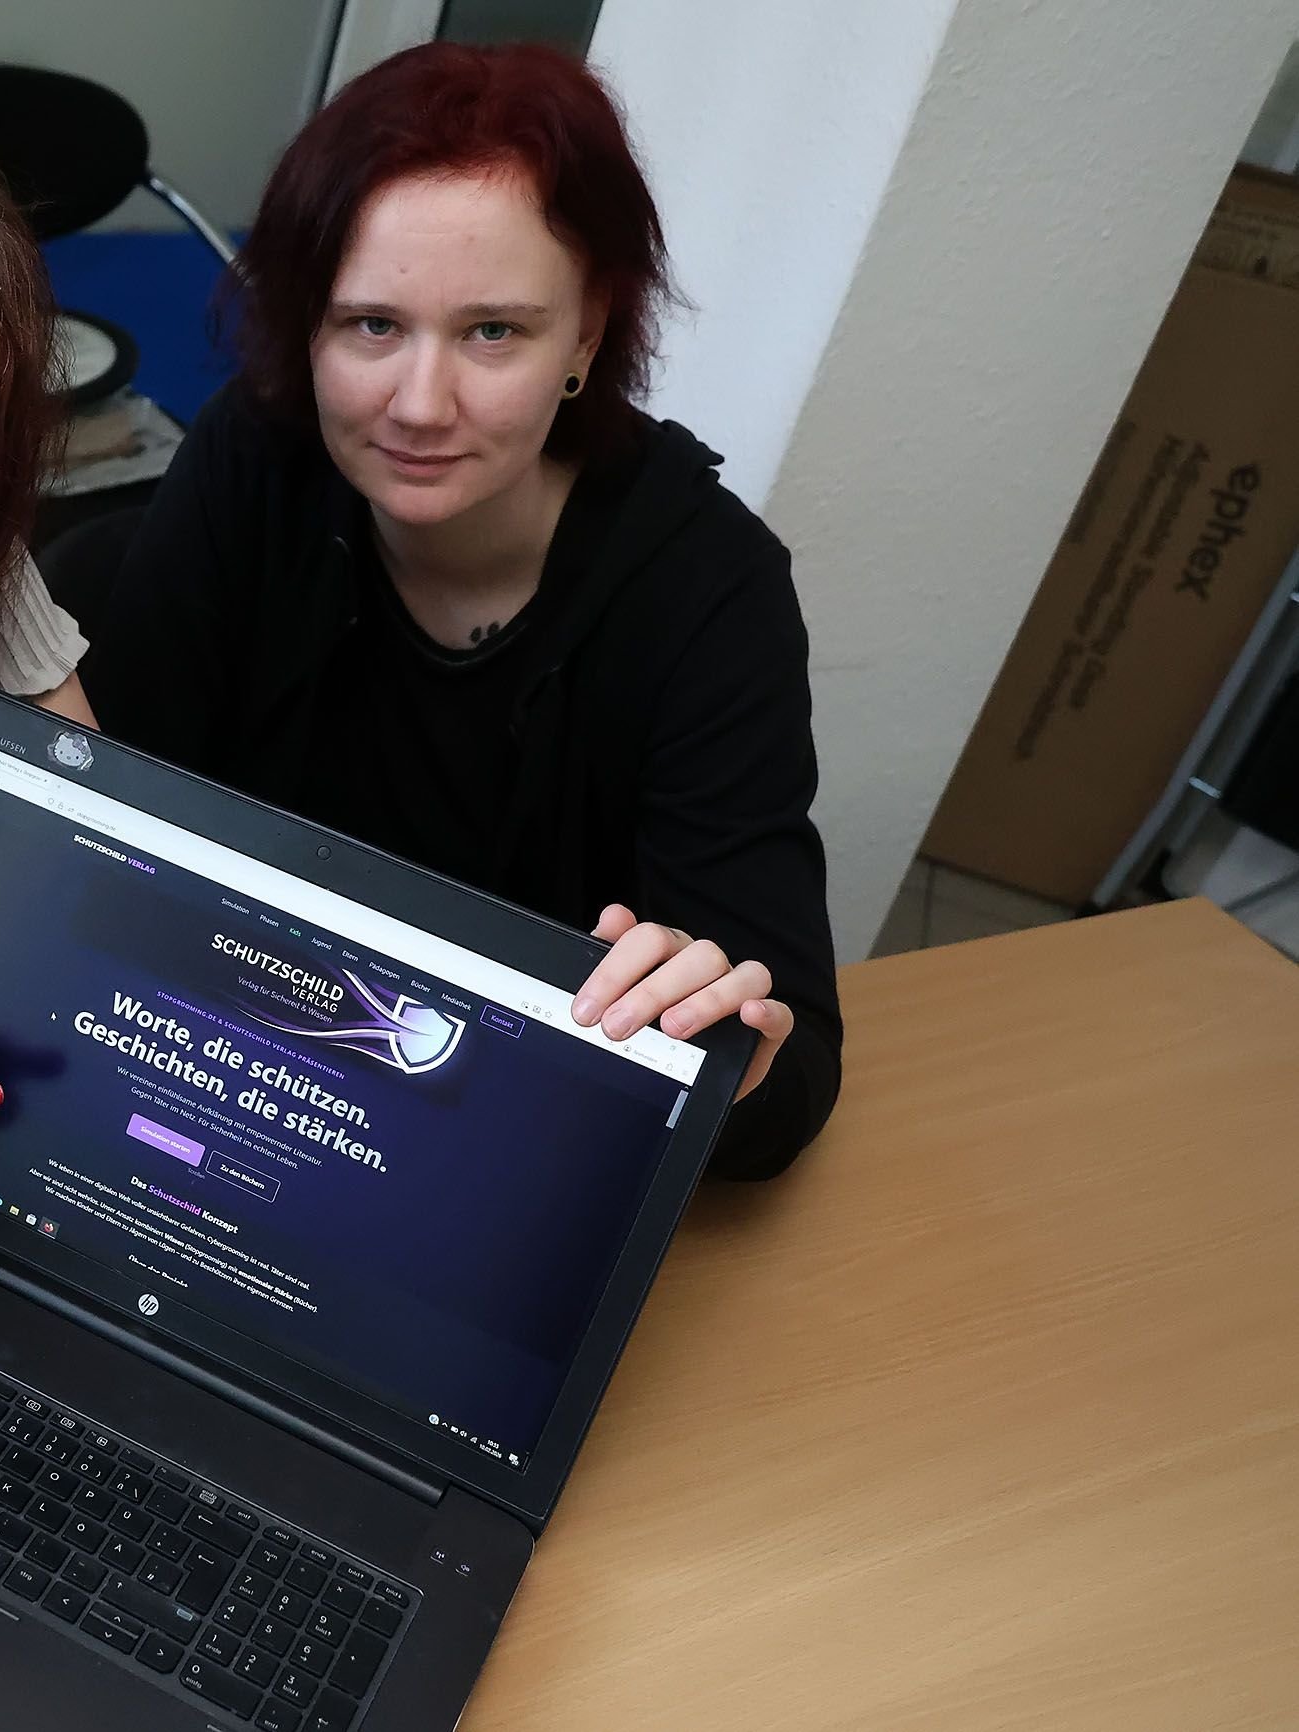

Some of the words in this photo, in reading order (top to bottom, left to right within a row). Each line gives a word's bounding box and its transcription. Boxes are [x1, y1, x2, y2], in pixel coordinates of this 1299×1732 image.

[1176, 462, 1259, 602] ephex
[73, 834, 126, 861] SCHUTZSCHILD
[128, 857, 155, 873] VERLAG
[221, 897, 249, 914] Simulation
[259, 914, 278, 926] Phasen
[289, 928, 300, 936] Kids
[311, 937, 331, 949] Jugend
[342, 950, 358, 961] Eltern
[410, 979, 430, 992] Bücher
[441, 993, 471, 1010] Mediathek
[211, 934, 343, 1000] SCHUTZSCHILD
[292, 985, 337, 1012] VERLAG
[491, 1015, 513, 1028] Kontakt
[224, 1021, 270, 1045] SCHUTZSCHILD
[272, 1042, 296, 1057] VERLAG
[297, 1054, 344, 1079] PRÄSENTIEREN
[113, 991, 193, 1050] Worte,
[203, 1036, 243, 1069] die
[248, 1061, 369, 1128] schützen.
[74, 1011, 227, 1101] Geschichten,
[237, 1087, 278, 1120] die
[282, 1112, 386, 1172] stärken.
[117, 1066, 128, 1075] Wir
[129, 1072, 156, 1089] vereinen
[157, 1086, 196, 1107] einfühlsame
[196, 1104, 233, 1126] Aufklärung
[233, 1121, 245, 1130] mit
[246, 1127, 292, 1151] empowernder
[293, 1148, 322, 1166] Literatur.
[131, 1086, 152, 1100] Gegen
[153, 1096, 169, 1107] Täter
[179, 1108, 195, 1121] Netz.
[197, 1117, 209, 1126] Für
[209, 1123, 242, 1142] Sicherheit
[242, 1138, 251, 1147] im
[252, 1144, 275, 1158] echten
[276, 1154, 297, 1169] Leben.
[219, 1163, 228, 1172] Zu
[228, 1168, 240, 1177] den
[240, 1173, 264, 1189] Büchern
[130, 1176, 146, 1189] Das
[147, 1184, 201, 1215] Schutzschild
[201, 1210, 238, 1233] Konzept
[138, 1294, 159, 1315] hp
[50, 1472, 60, 1481] O
[2, 1483, 12, 1492] K
[85, 1490, 95, 1498] P
[39, 1503, 45, 1512] L
[245, 1575, 252, 1583] 7
[281, 1595, 289, 1604] 8
[227, 1605, 235, 1613] 4
[319, 1615, 327, 1624] 9
[265, 1624, 273, 1633] 5
[212, 1634, 217, 1642] 1
[303, 1645, 311, 1654] 6
[248, 1654, 256, 1663] 2
[192, 1665, 200, 1674] 0
[287, 1675, 295, 1684] 3
